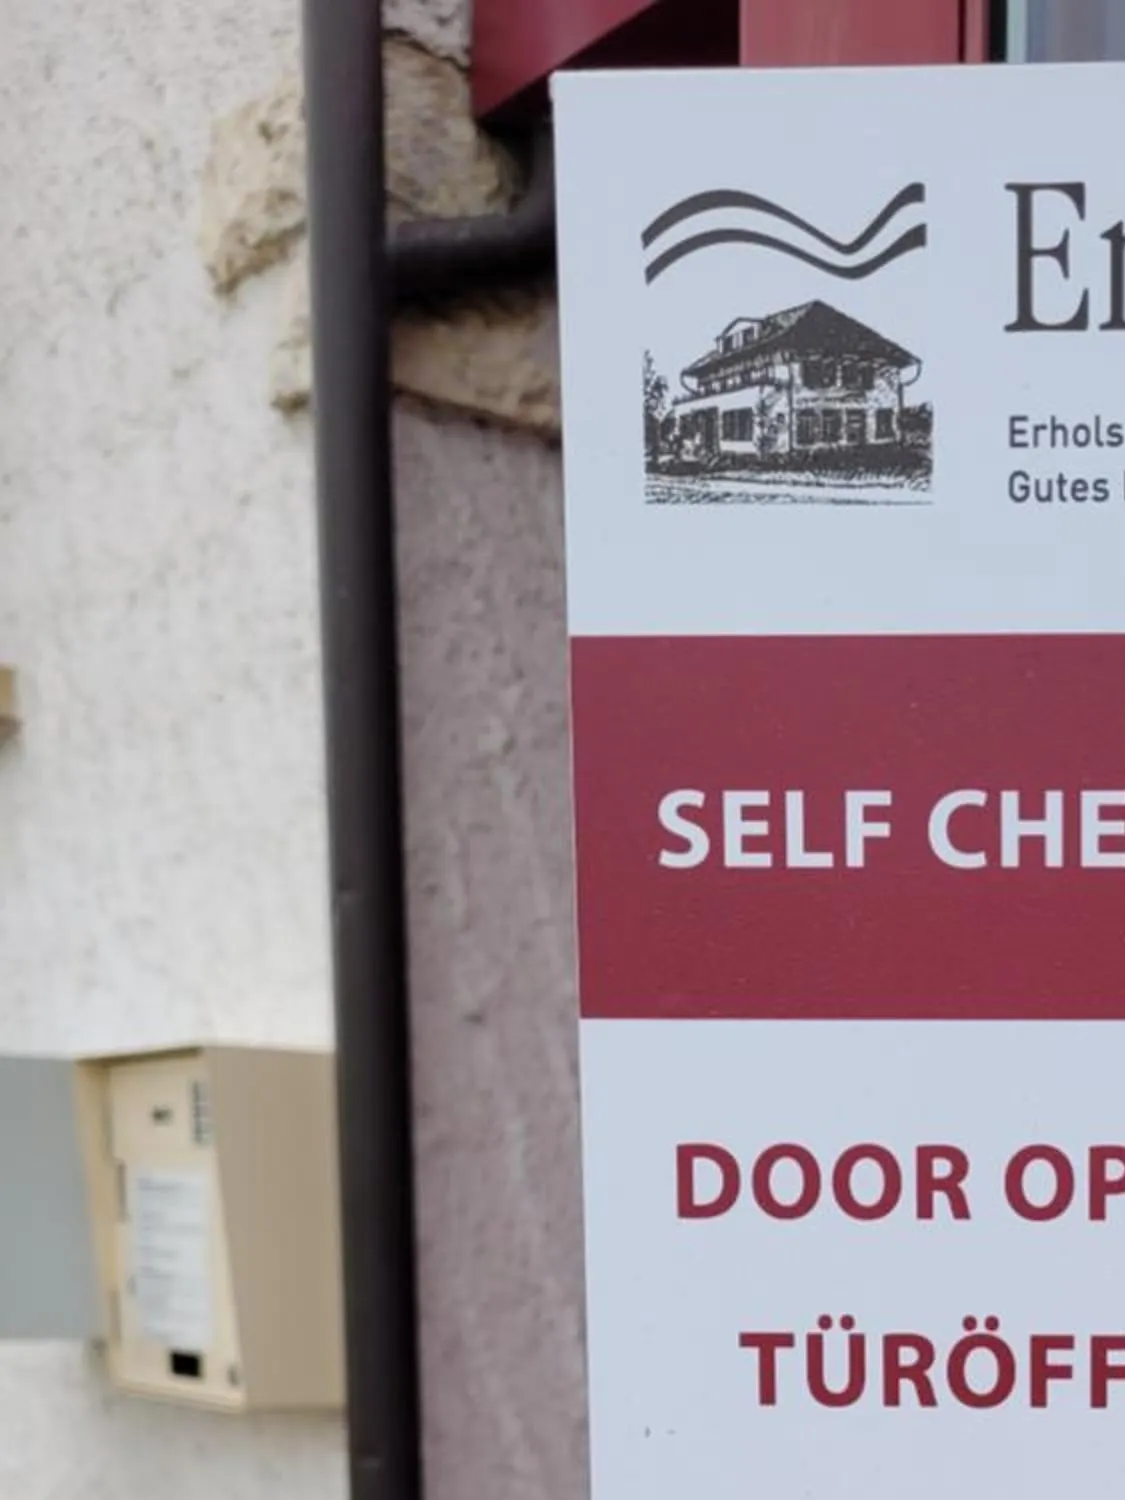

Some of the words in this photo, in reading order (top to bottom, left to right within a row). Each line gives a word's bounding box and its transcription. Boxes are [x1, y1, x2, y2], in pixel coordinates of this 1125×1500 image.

[1008, 469, 1110, 504] Gutes
[658, 789, 892, 869] SELF
[676, 1143, 971, 1221] DOOR
